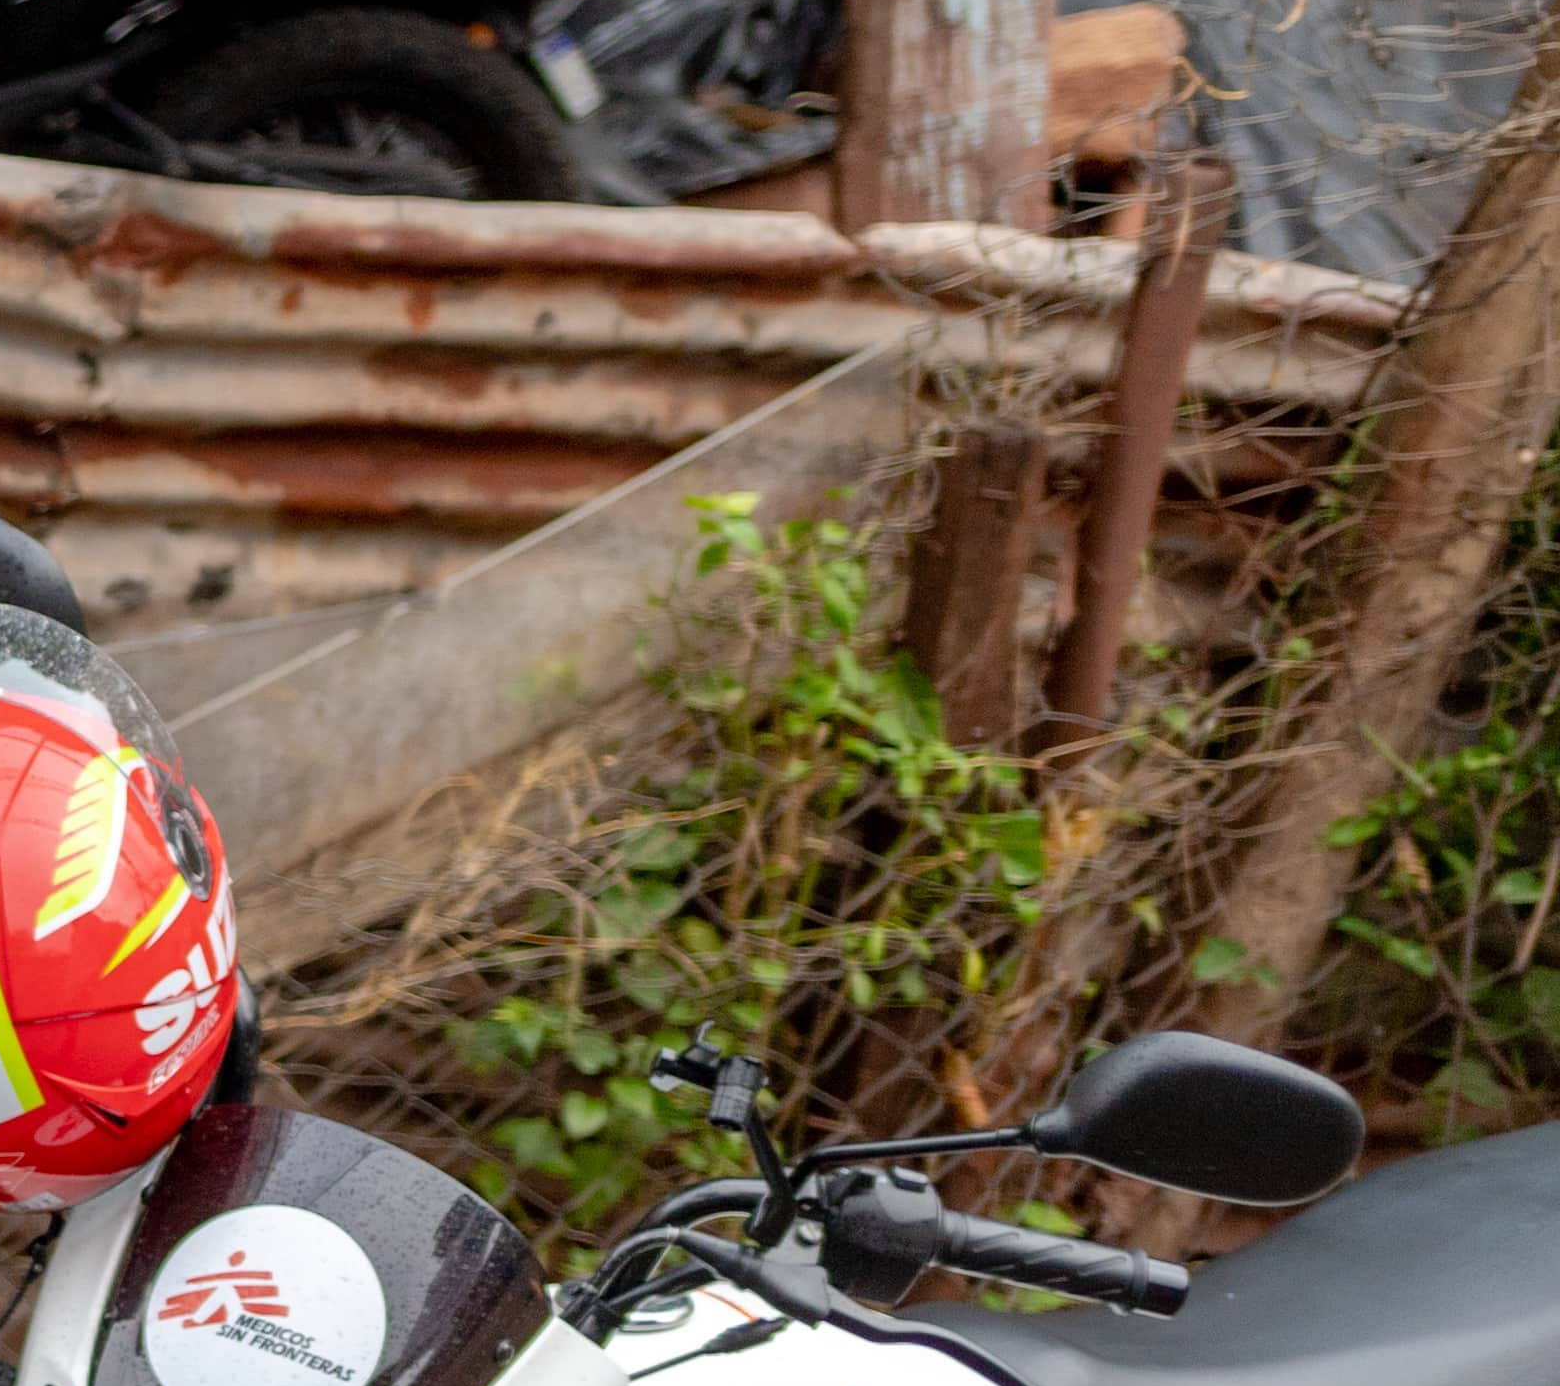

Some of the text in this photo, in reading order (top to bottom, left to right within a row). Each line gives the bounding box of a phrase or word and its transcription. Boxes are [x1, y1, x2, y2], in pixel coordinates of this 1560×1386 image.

[216, 1324, 356, 1382] SIN FRONTERAS
[235, 1314, 316, 1350] MEDICOS
